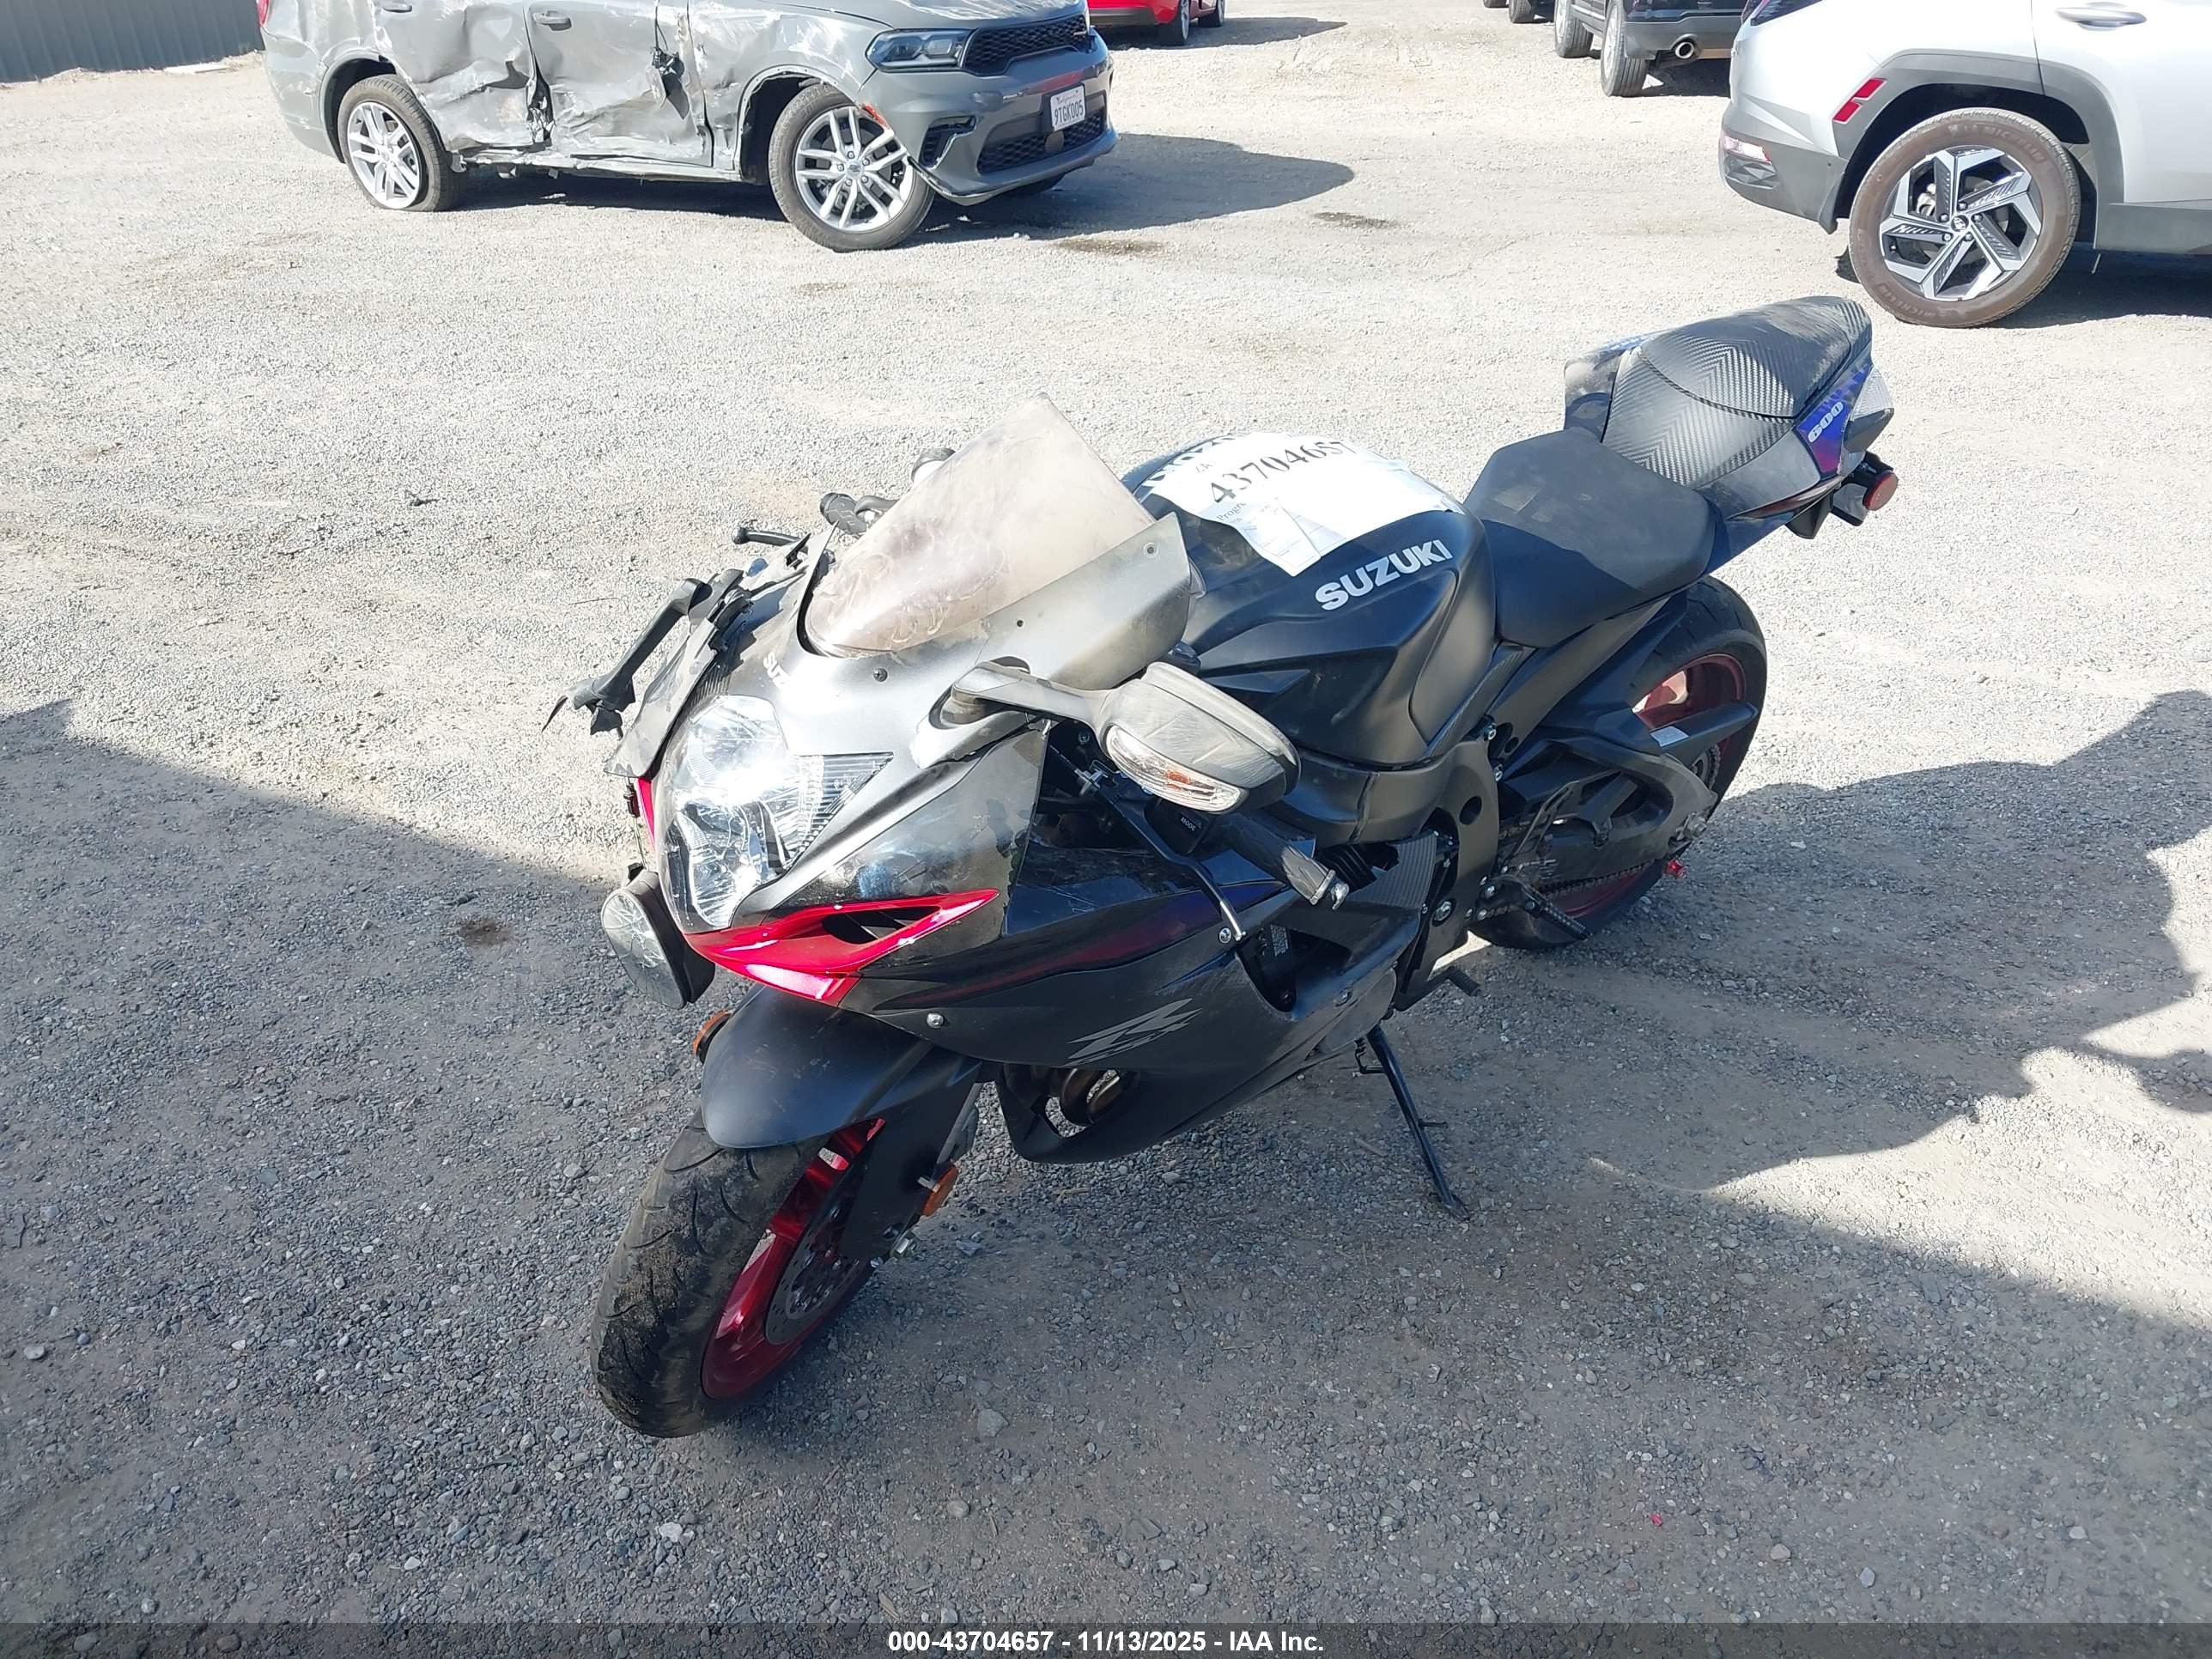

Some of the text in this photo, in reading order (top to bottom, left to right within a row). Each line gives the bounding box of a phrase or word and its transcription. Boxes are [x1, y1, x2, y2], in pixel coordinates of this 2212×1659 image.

[1054, 100, 1084, 126] 9TGK005
[1808, 401, 1844, 443] 600
[1212, 441, 1358, 504] 43704657
[1315, 538, 1454, 611] SUZUKI
